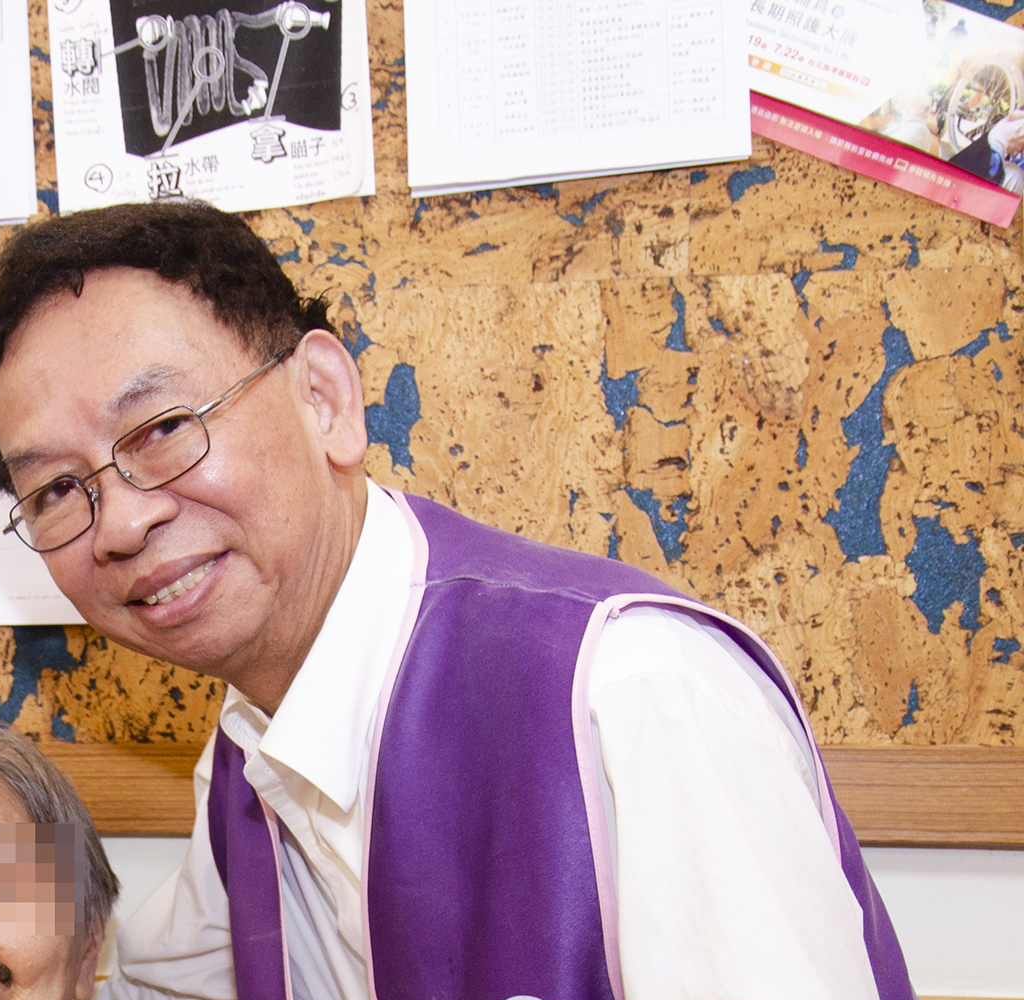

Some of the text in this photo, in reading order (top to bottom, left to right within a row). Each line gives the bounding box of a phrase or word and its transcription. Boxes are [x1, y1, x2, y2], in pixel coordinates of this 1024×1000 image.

[750, 0, 858, 47] 長期照護大展
[60, 38, 98, 77] 轉
[779, 29, 821, 51] Technology
[835, 50, 850, 61] Life
[250, 124, 288, 163] 拿
[291, 137, 326, 160] 瞄子
[147, 161, 182, 199] 拉
[184, 155, 219, 175] 水帶
